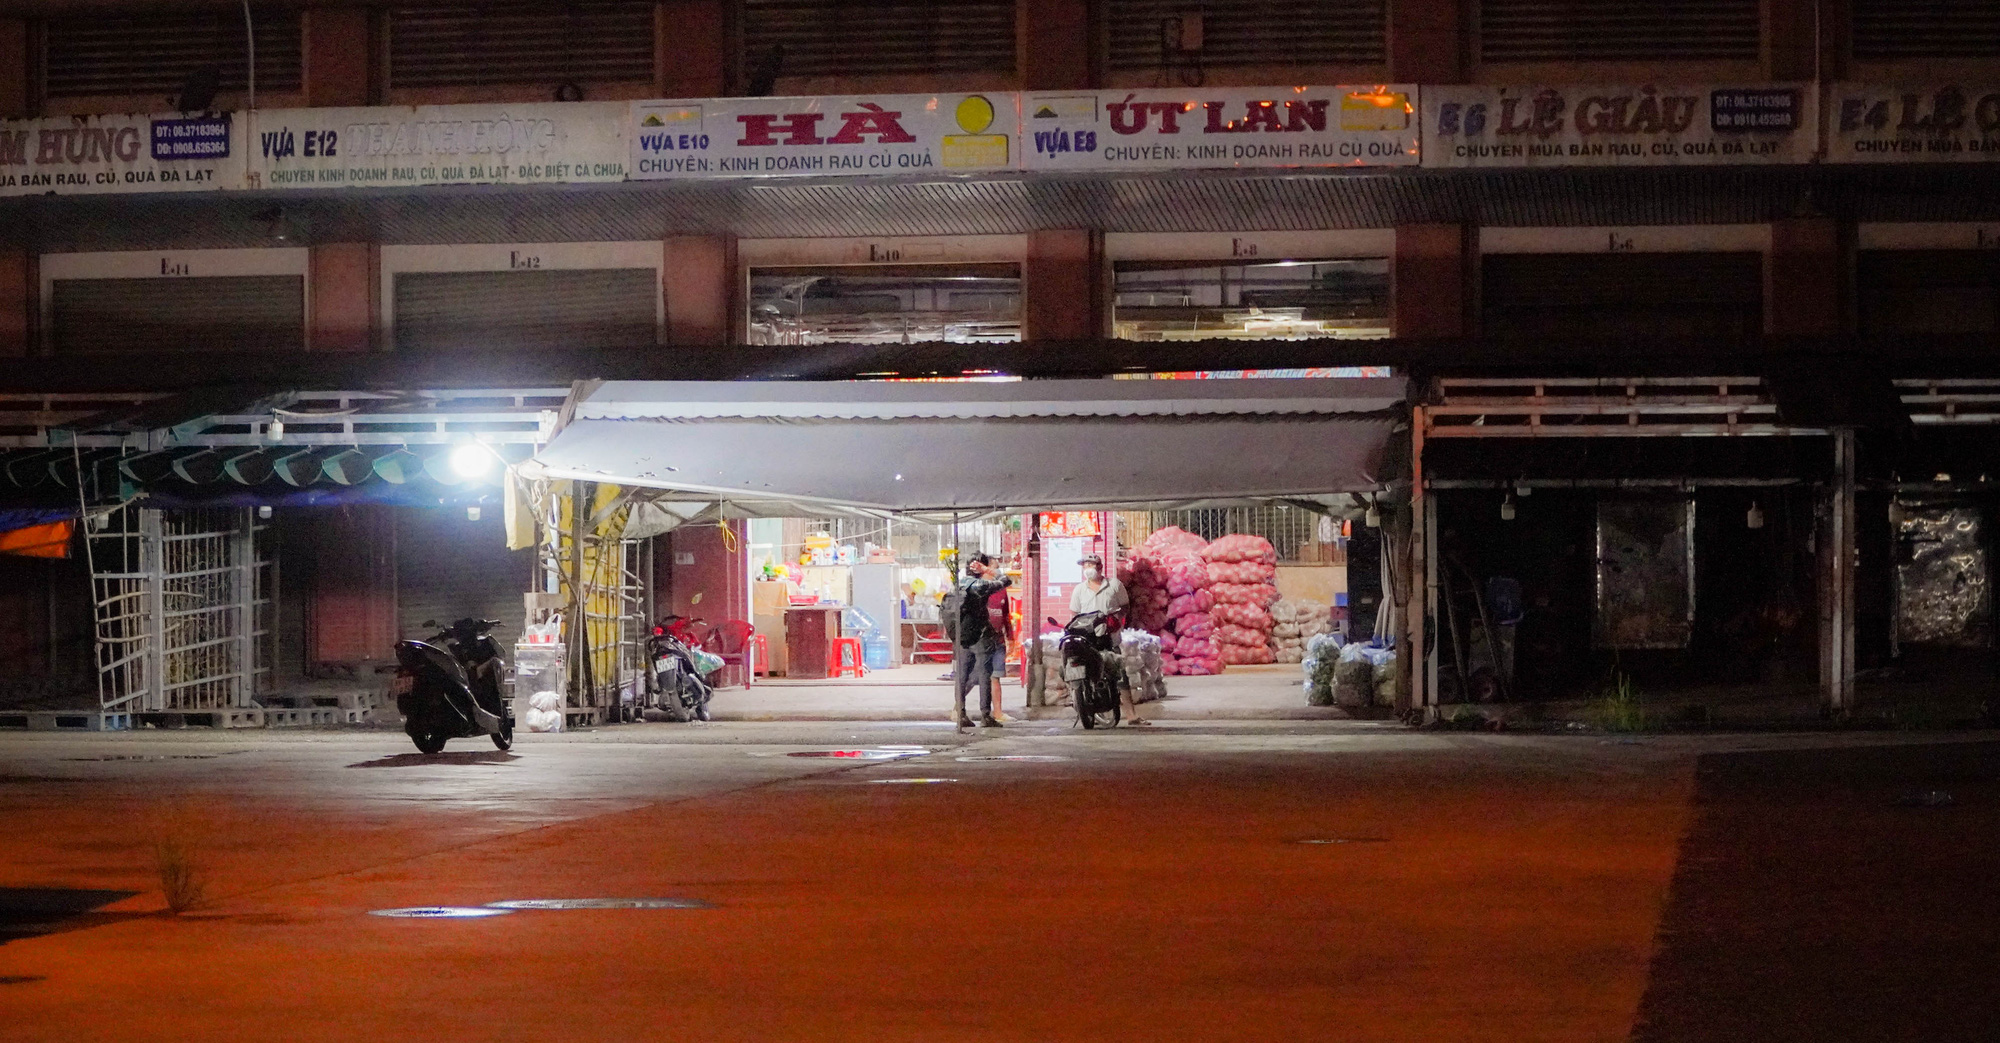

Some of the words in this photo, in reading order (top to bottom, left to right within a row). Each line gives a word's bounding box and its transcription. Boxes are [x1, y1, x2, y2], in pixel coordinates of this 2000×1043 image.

[737, 102, 916, 147] HÀ
[1106, 93, 1188, 135] ÚT
[1203, 99, 1331, 134] LAN
[35, 117, 141, 165] HÙNG
[261, 126, 295, 161] VỰA
[303, 130, 338, 157] E12
[640, 132, 674, 154] VỰA
[679, 134, 710, 150] E10
[1034, 127, 1071, 159] VỰA
[1074, 130, 1098, 153] E8
[1104, 143, 1180, 161] CHUYÊN:
[1187, 145, 1227, 159] KINH
[1233, 143, 1292, 159] DOANH
[1299, 142, 1333, 158] RAU
[1339, 138, 1362, 157] CỦ
[1369, 137, 1404, 157] QUẢ
[1528, 143, 1563, 157] MUA
[1608, 142, 1647, 158] RAU,
[319, 169, 345, 182] KINH
[350, 168, 386, 181] DOANH
[392, 167, 417, 182] RAU,
[442, 162, 464, 180] QUẢ
[546, 161, 570, 180] BIỆT
[594, 164, 623, 177] CHUA
[639, 155, 714, 173] CHUYÊN:
[720, 157, 759, 171] KINH
[765, 156, 823, 171] DOANH
[829, 154, 863, 169] RAU
[869, 149, 892, 168] CỦ
[899, 147, 933, 168] QUẢ
[56, 173, 90, 187] RAU,
[96, 168, 120, 186] CỦ,
[125, 167, 155, 183] QUẢ
[186, 170, 213, 185] LẠT
